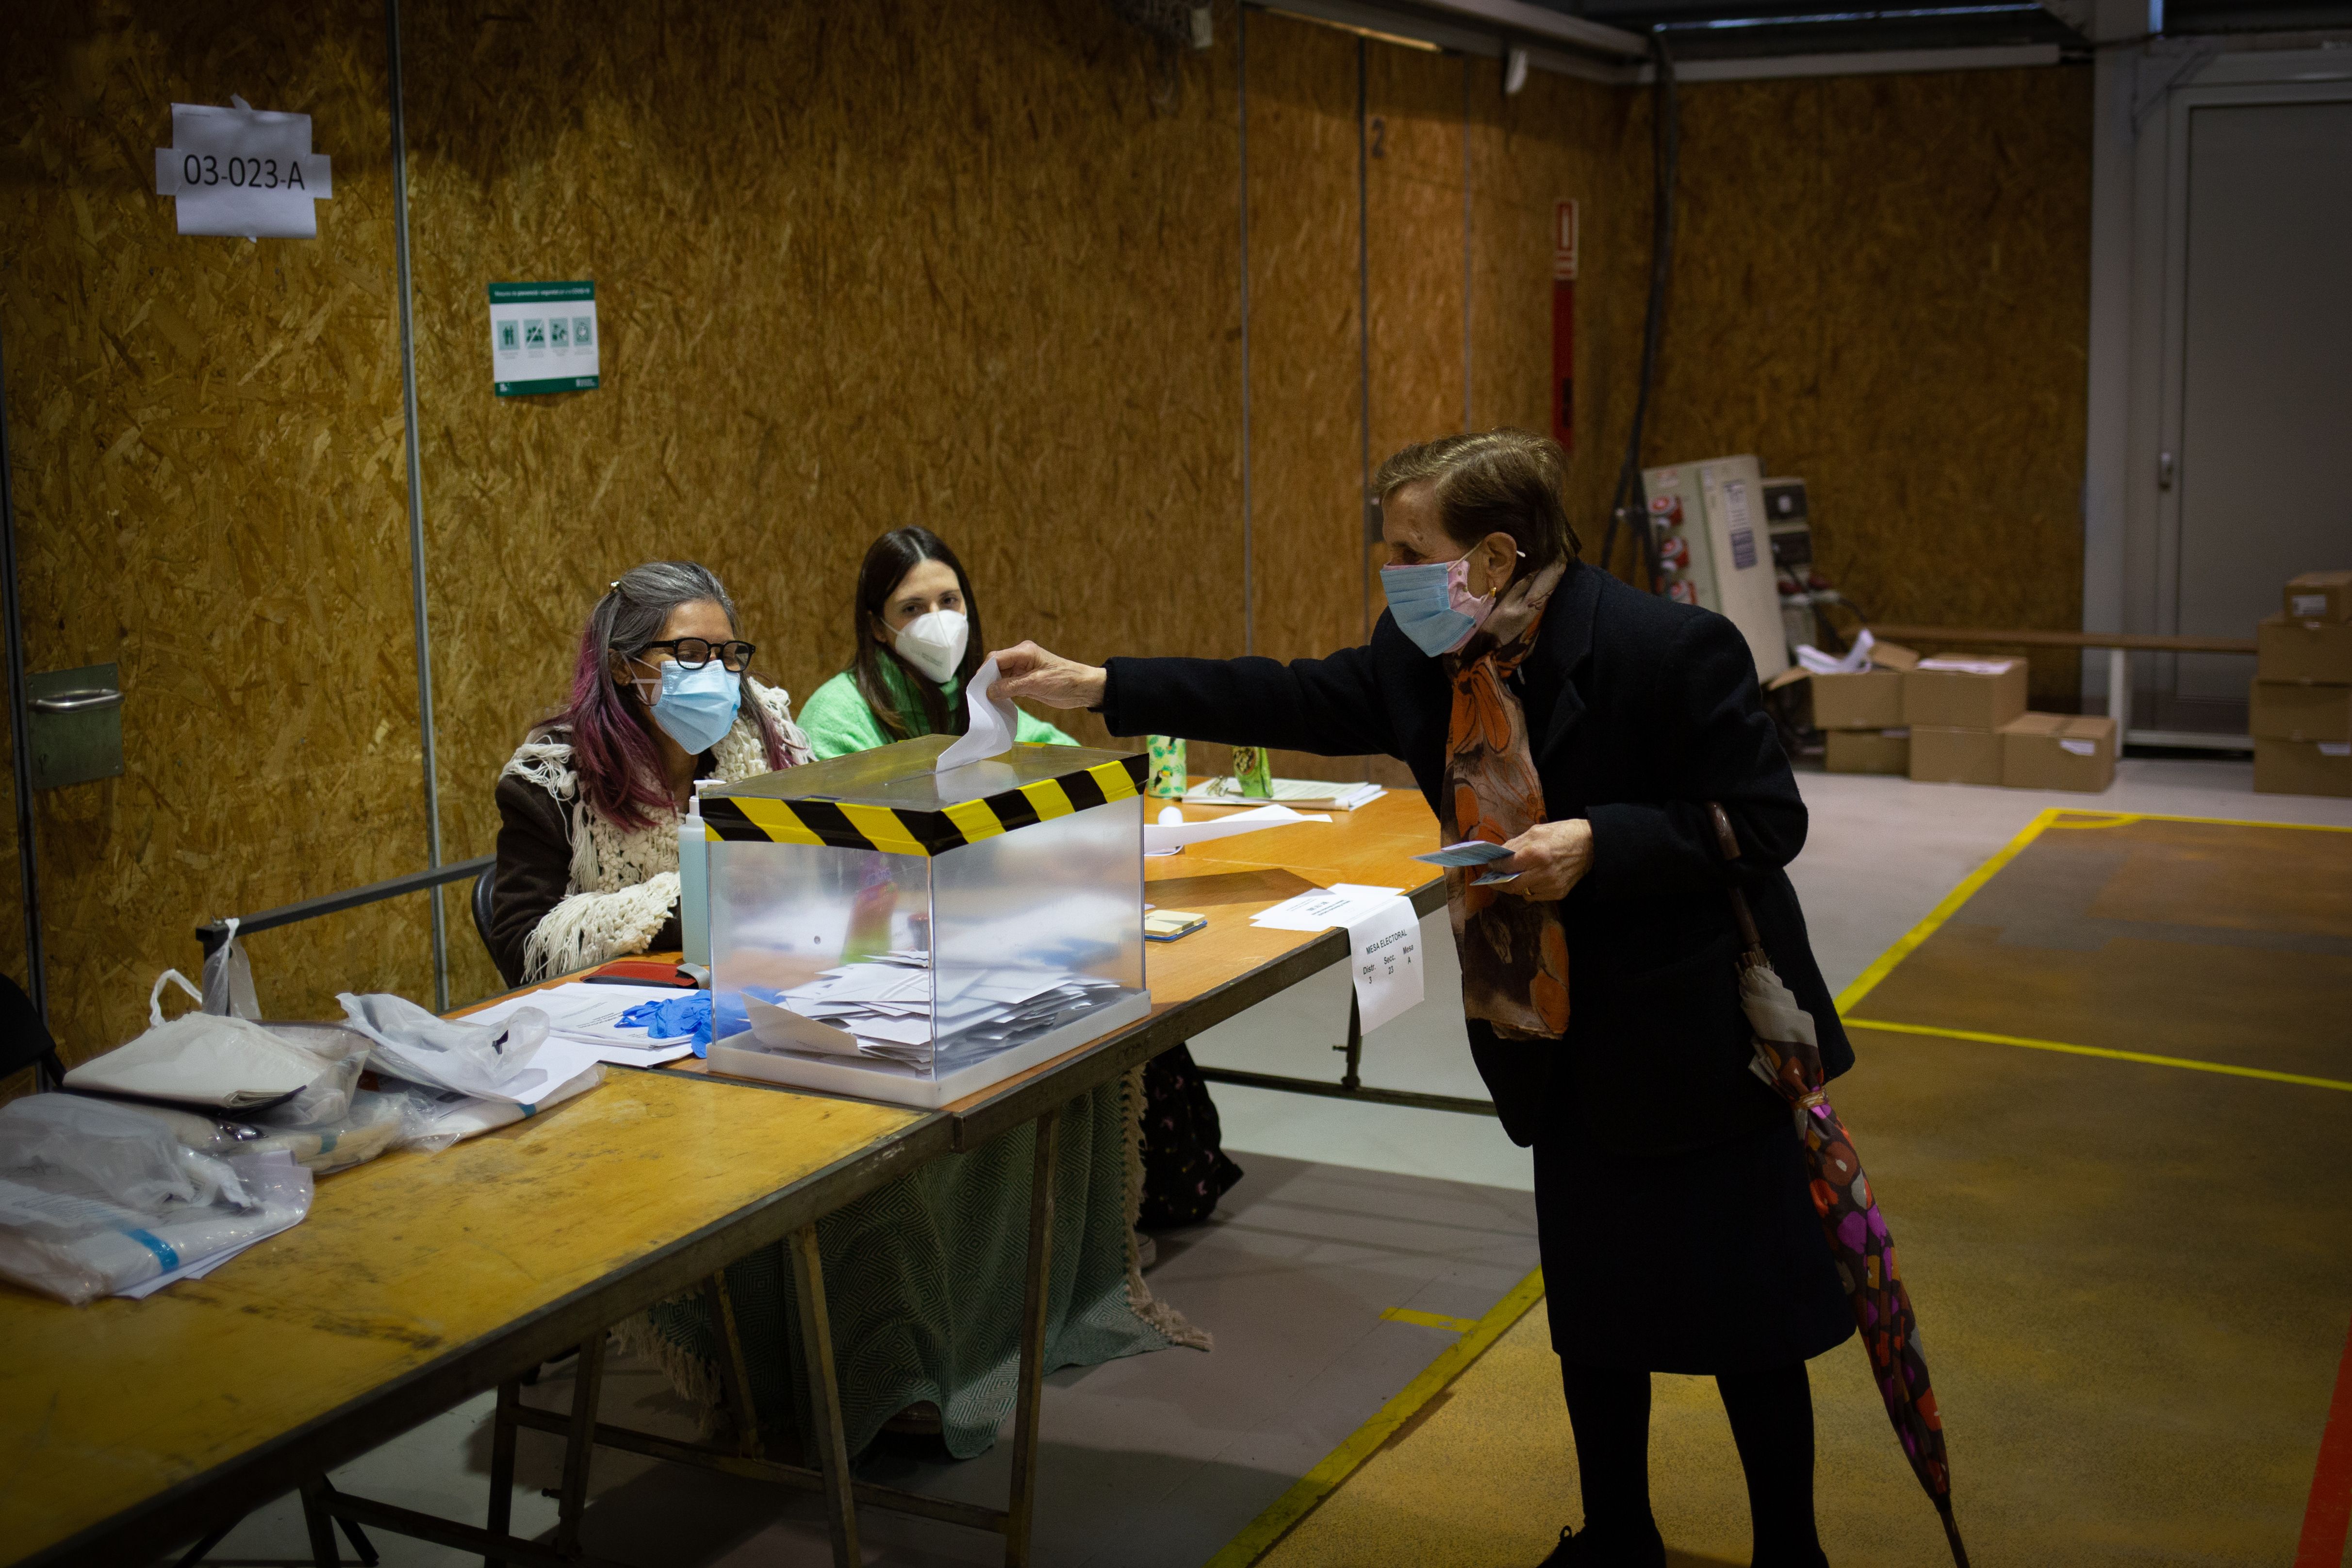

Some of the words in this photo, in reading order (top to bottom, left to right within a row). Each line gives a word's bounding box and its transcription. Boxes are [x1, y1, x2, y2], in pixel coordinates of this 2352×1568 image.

[183, 154, 305, 190] 03-023-A
[1366, 942, 1380, 955] MESA
[1380, 929, 1408, 948] ELECTORAL
[1363, 963, 1377, 975] Distr.
[1383, 955, 1396, 965] Secc.
[1402, 944, 1414, 955] Mesa
[1368, 976, 1372, 984] 3
[1388, 966, 1394, 974] 23
[1407, 957, 1412, 965] A
